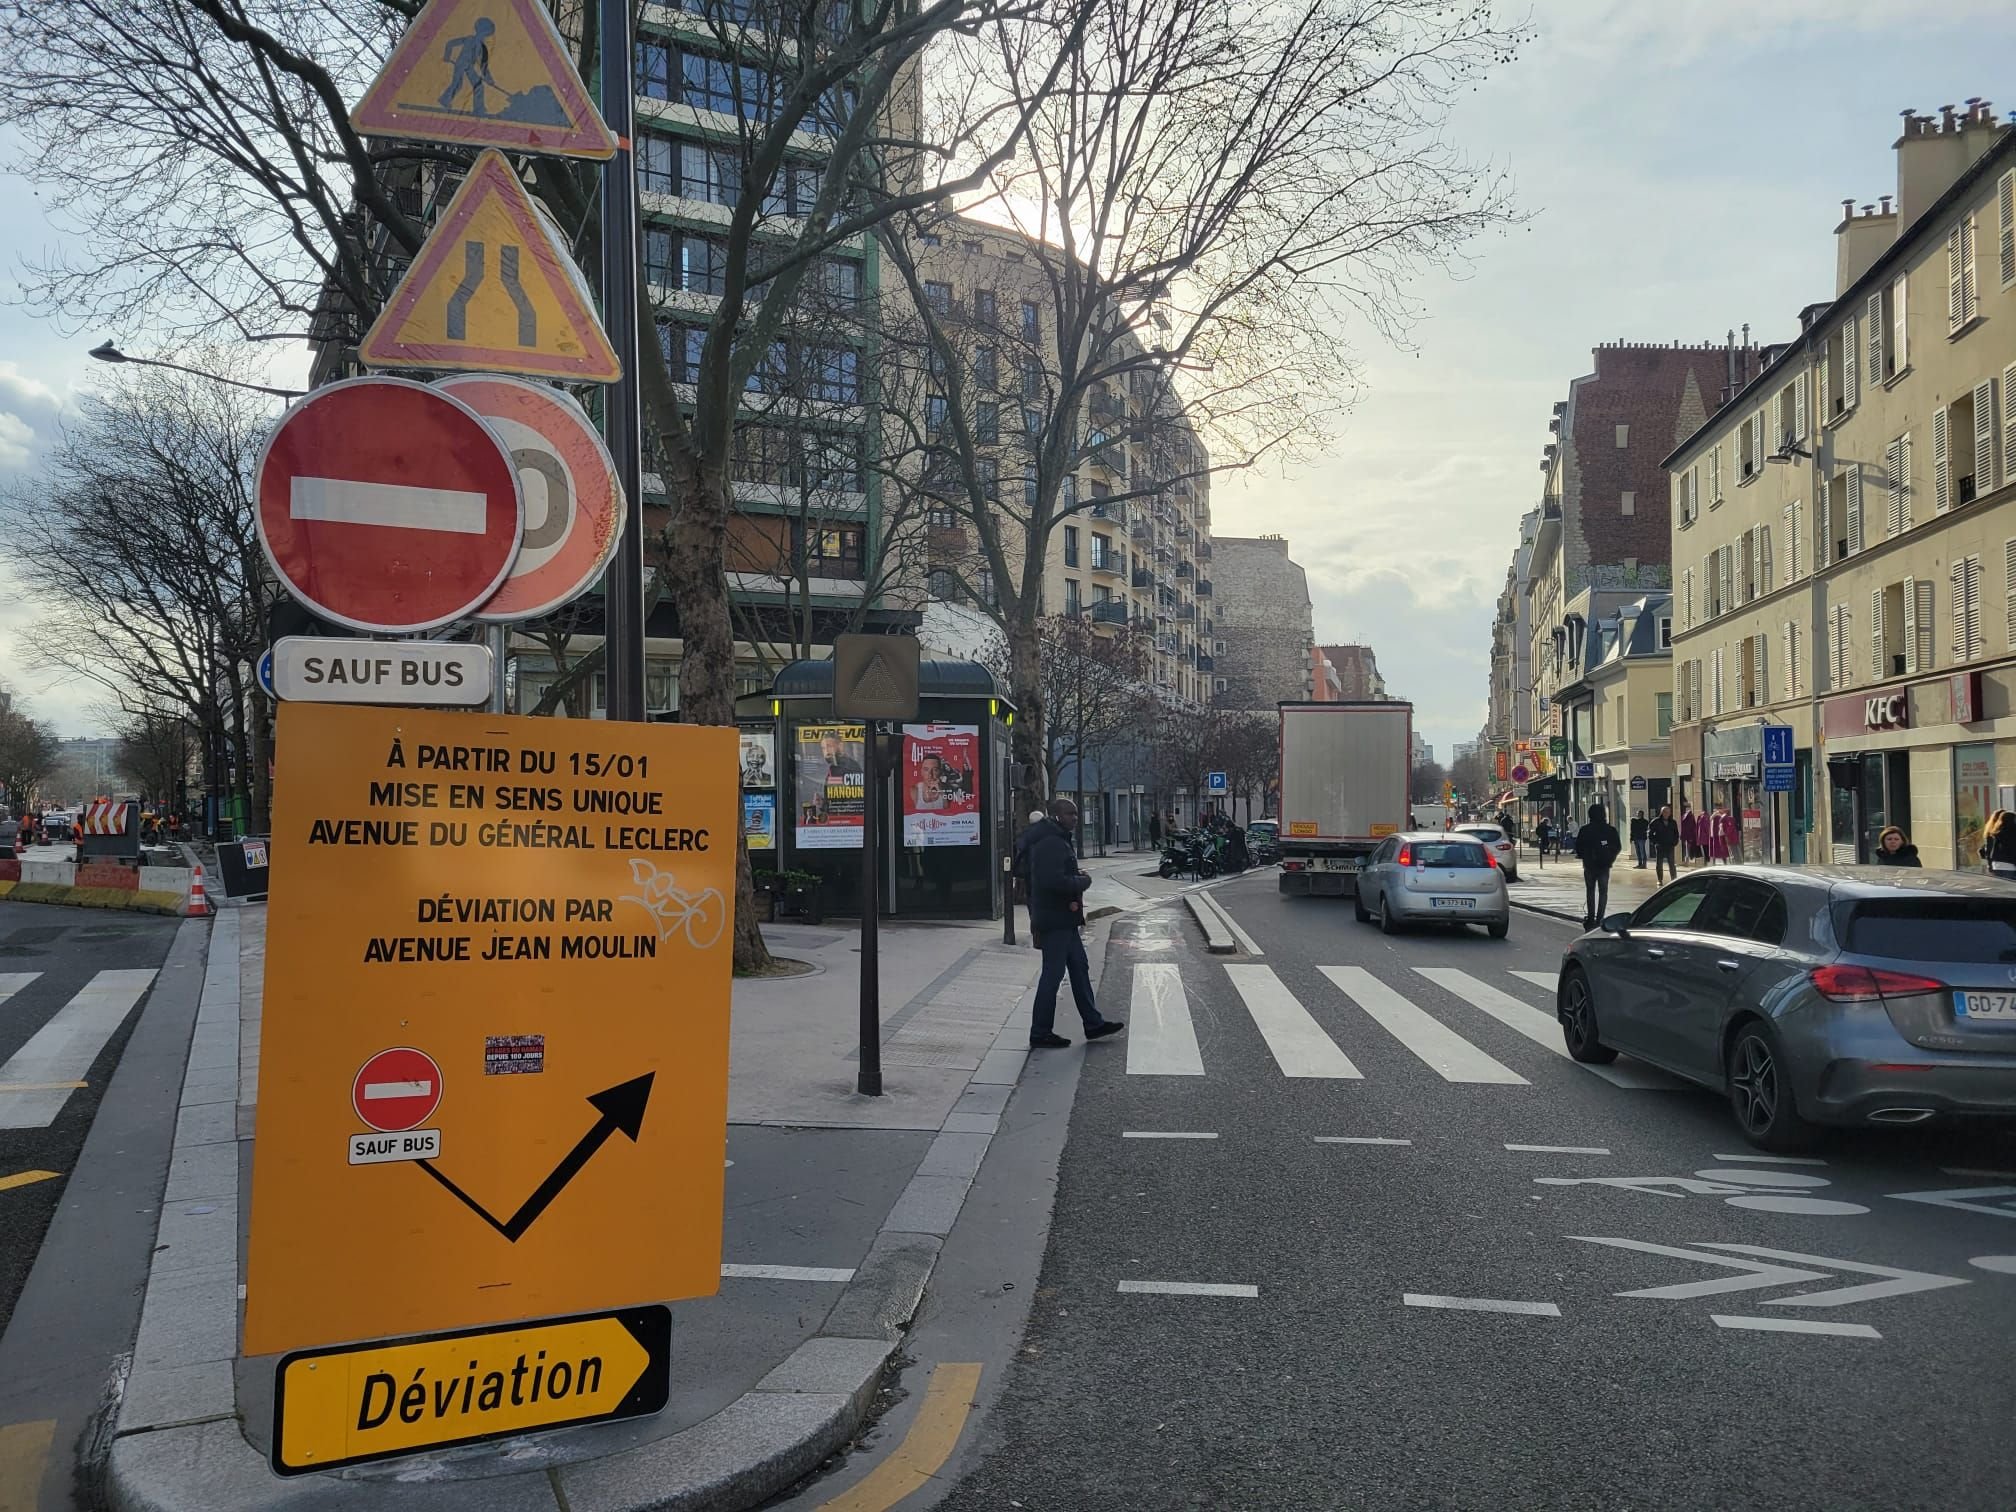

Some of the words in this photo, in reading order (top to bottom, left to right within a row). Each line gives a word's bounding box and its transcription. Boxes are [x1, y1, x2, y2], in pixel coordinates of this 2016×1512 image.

[511, 448, 569, 550] 0
[303, 657, 392, 685] SAUF
[402, 660, 463, 687] BUS
[1864, 695, 1898, 726] KFC
[387, 738, 406, 768] À
[417, 745, 510, 773] PARTIR
[520, 750, 555, 774] DU
[569, 753, 648, 778] 15/01
[827, 786, 865, 799] HANOUN
[843, 773, 864, 786] CYRI
[1214, 776, 1221, 787] P
[369, 782, 438, 807] MISE
[449, 785, 484, 809] EN
[496, 787, 563, 811] SENS
[573, 790, 663, 815] UNIQUE
[308, 820, 418, 846] AVENUE
[431, 823, 467, 847] DU
[479, 819, 595, 848] GÉNÉRAL
[605, 827, 709, 852] LECLERC
[418, 893, 555, 923] DÉVIATION
[565, 899, 613, 922] PAR
[364, 937, 471, 963] AVENUE
[482, 936, 551, 961] JEAN
[561, 936, 656, 959] MOULIN
[486, 1053, 509, 1061] DEPUIS
[355, 1139, 397, 1156] SAUF
[403, 1136, 435, 1153] BUS
[357, 1351, 602, 1431] Déviation
